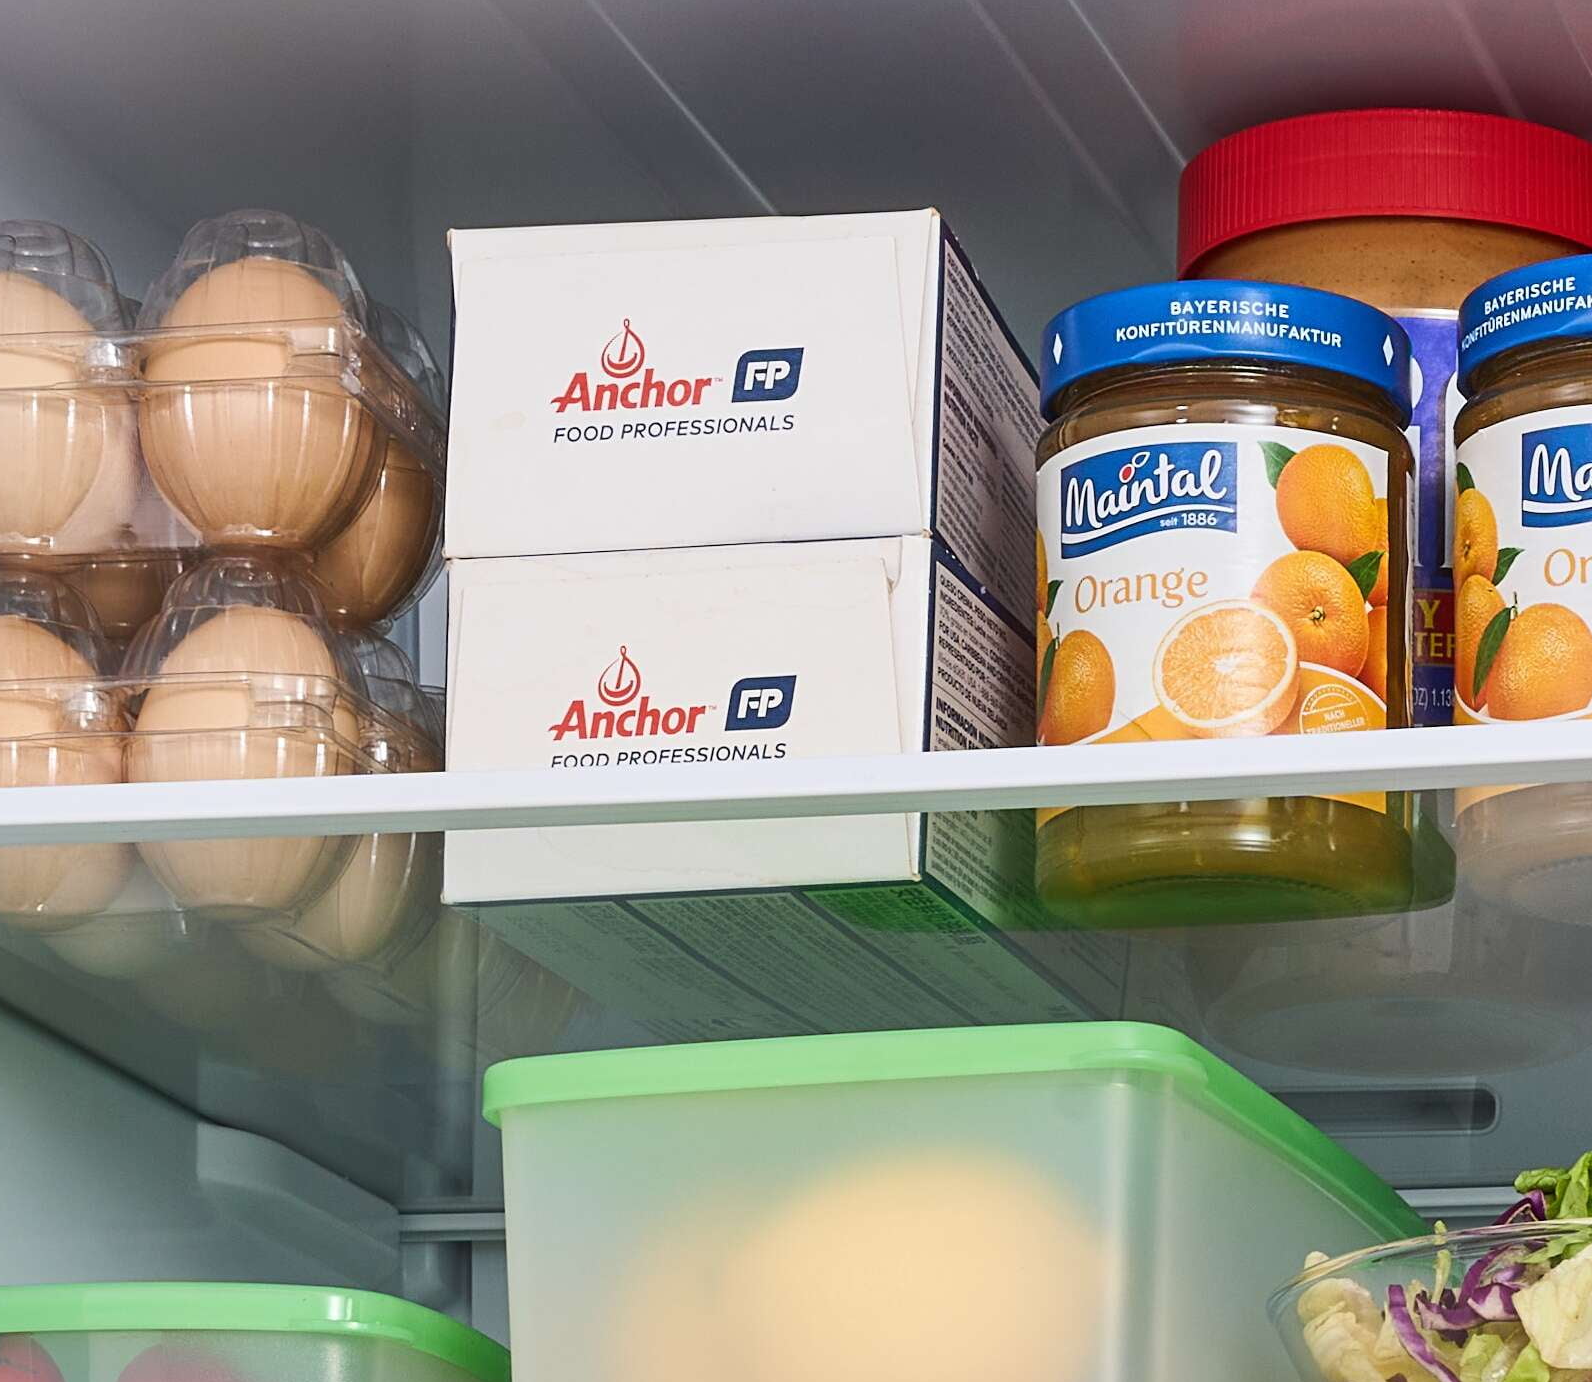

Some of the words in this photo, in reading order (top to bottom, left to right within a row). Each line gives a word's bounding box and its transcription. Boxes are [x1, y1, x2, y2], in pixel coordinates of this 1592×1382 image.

[1170, 300, 1290, 319] BAYERISCHE
[1484, 276, 1576, 316] BAYERISCHE
[1115, 319, 1343, 348] KONFITÜRENMANUFAKTUR
[550, 368, 713, 414] Anchor
[553, 425, 614, 443] FOOD
[621, 415, 795, 440] PROFESSIONALS
[1065, 448, 1228, 530] Maintal
[1159, 515, 1178, 529] seit
[1181, 510, 1217, 528] 1886
[1074, 566, 1209, 614] Orange
[1432, 688, 1454, 708] 1.13
[548, 696, 707, 741] Anchor
[551, 753, 610, 768] FOOD
[616, 742, 786, 767] PROFESSIONALS
